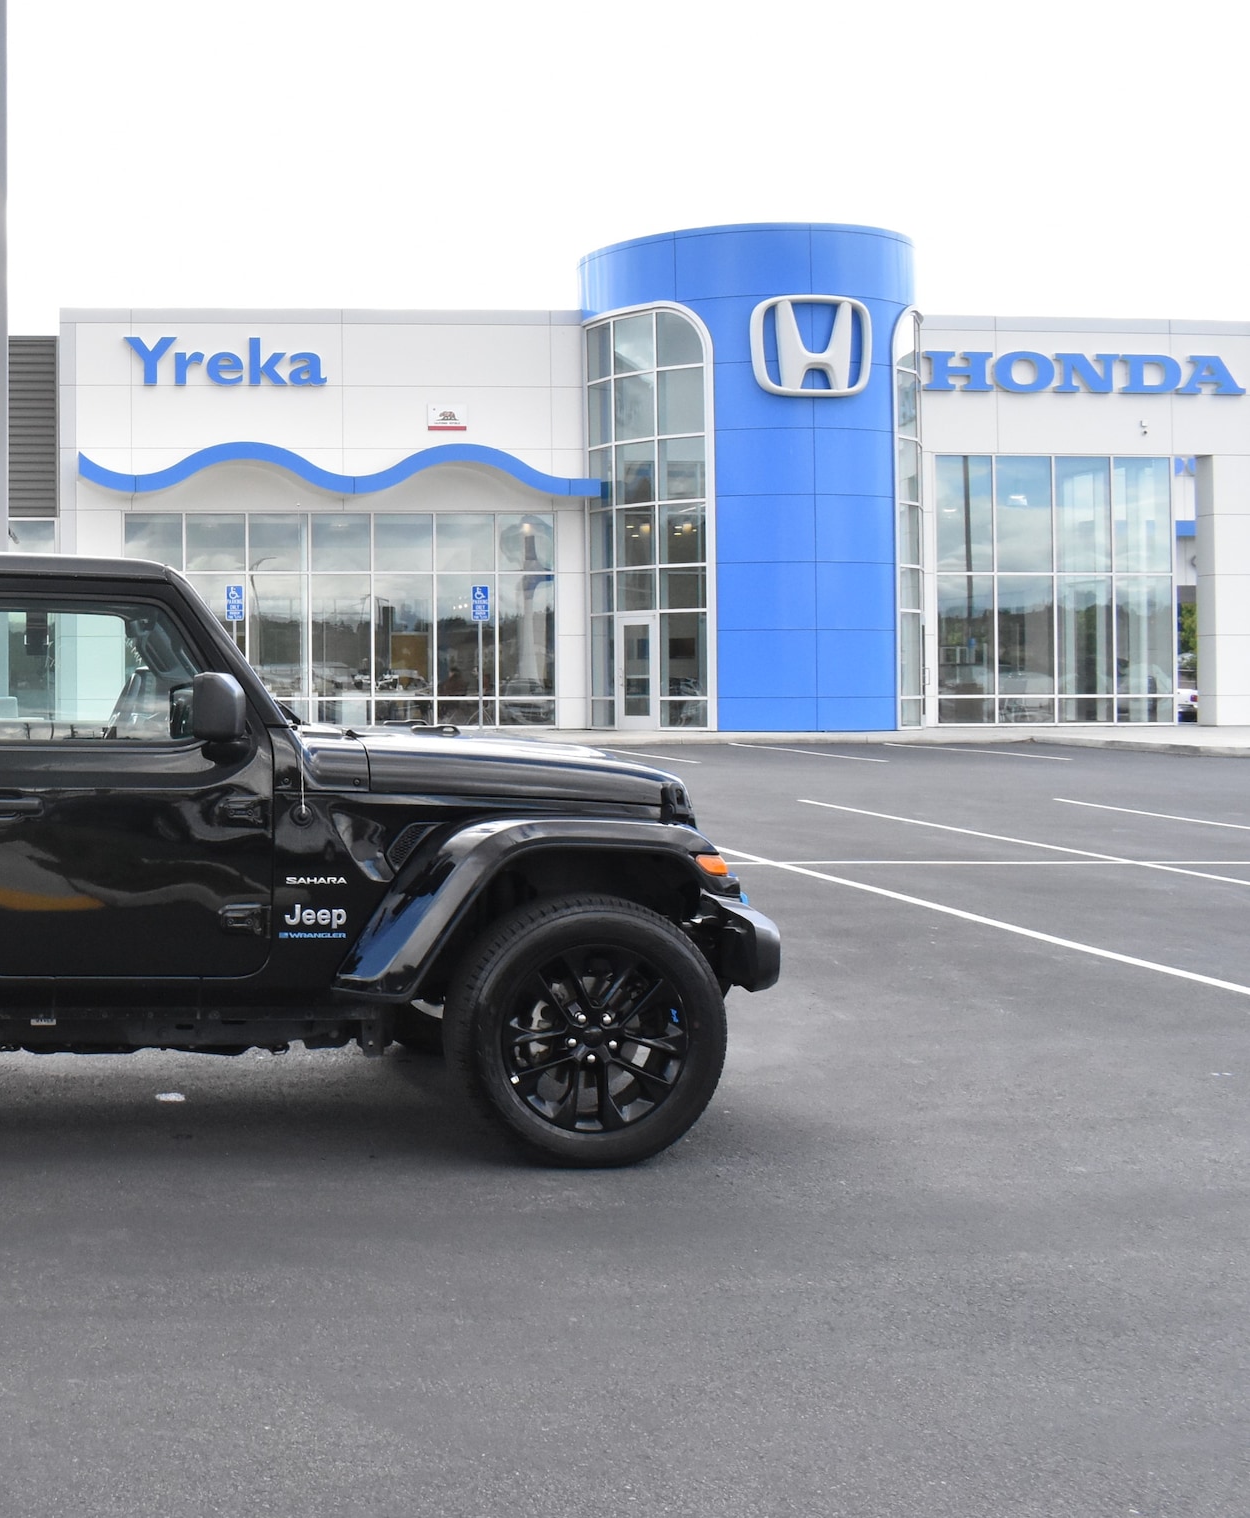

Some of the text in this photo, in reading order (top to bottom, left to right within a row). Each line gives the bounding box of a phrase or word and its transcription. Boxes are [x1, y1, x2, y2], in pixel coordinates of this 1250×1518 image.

[123, 336, 328, 386] Yreka
[922, 350, 1247, 395] HONDA
[285, 876, 348, 885] SAHARA
[284, 903, 347, 929] Jeep
[289, 931, 347, 939] WRANGLER
